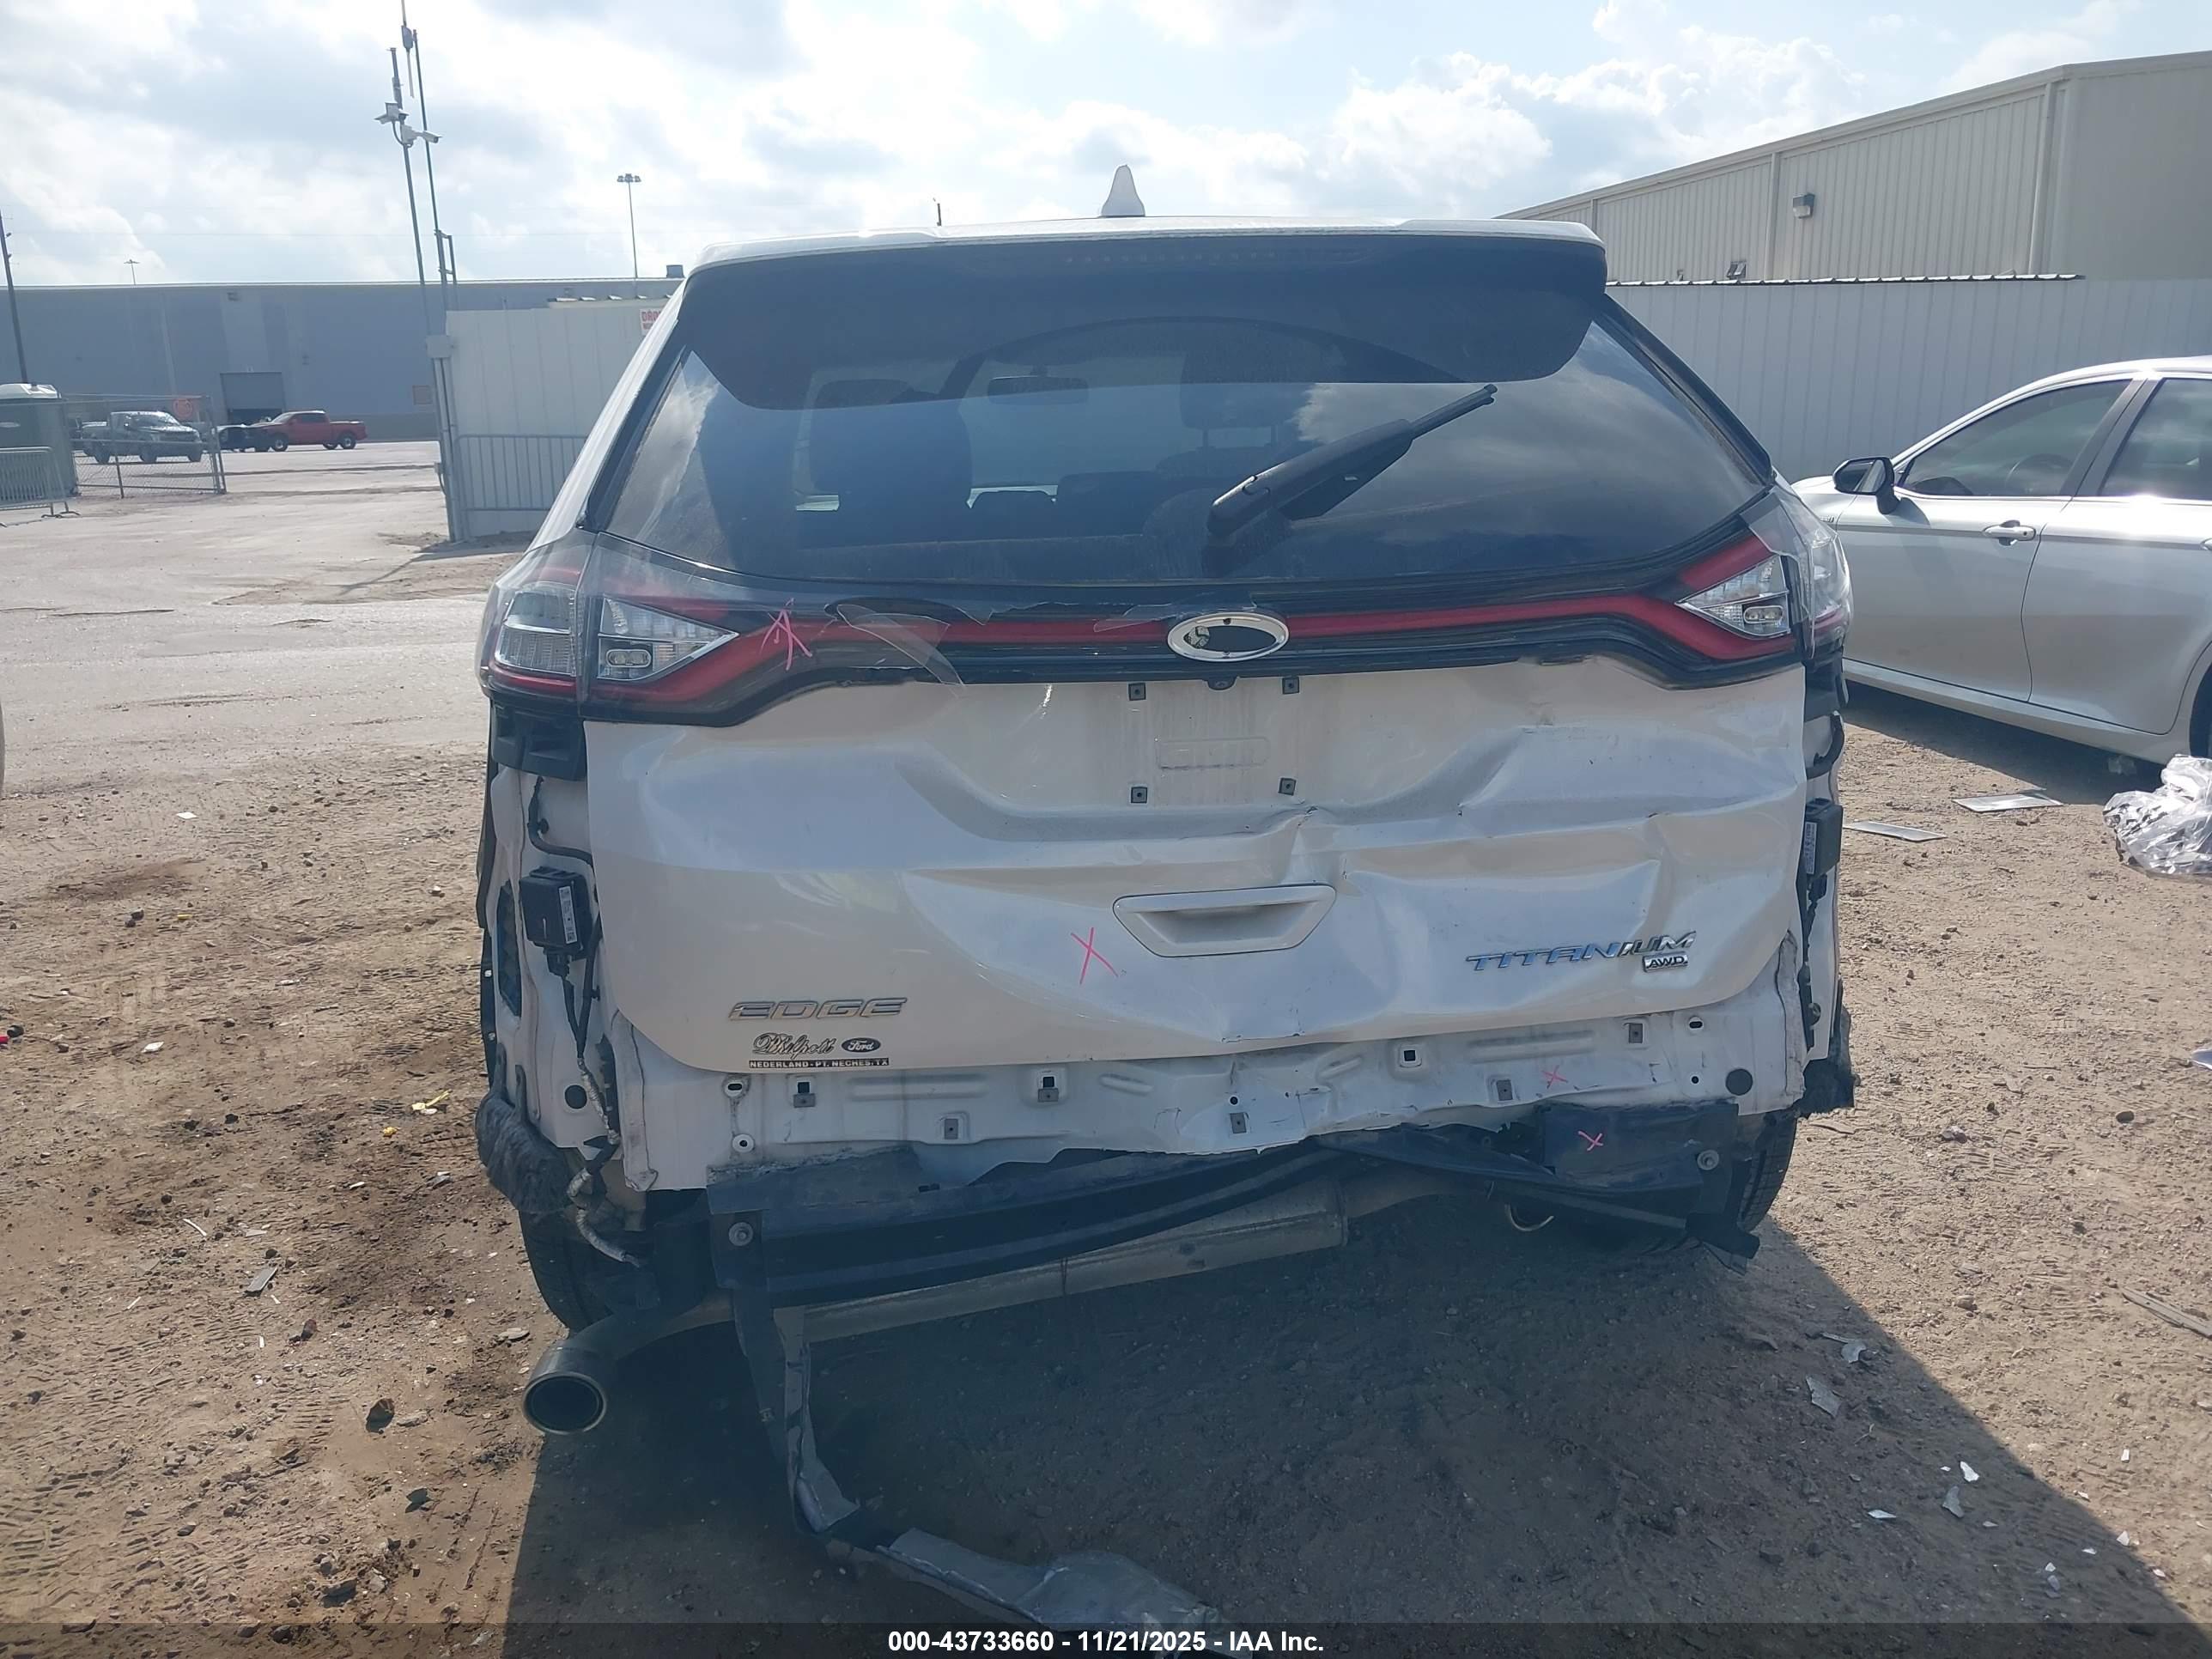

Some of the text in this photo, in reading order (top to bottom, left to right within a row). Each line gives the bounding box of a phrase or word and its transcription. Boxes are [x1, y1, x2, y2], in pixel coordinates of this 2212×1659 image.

[1465, 930, 1697, 972] TITANIUM
[1646, 956, 1688, 969] AWD
[728, 997, 908, 1021] EDGE
[847, 1039, 876, 1052] Ford
